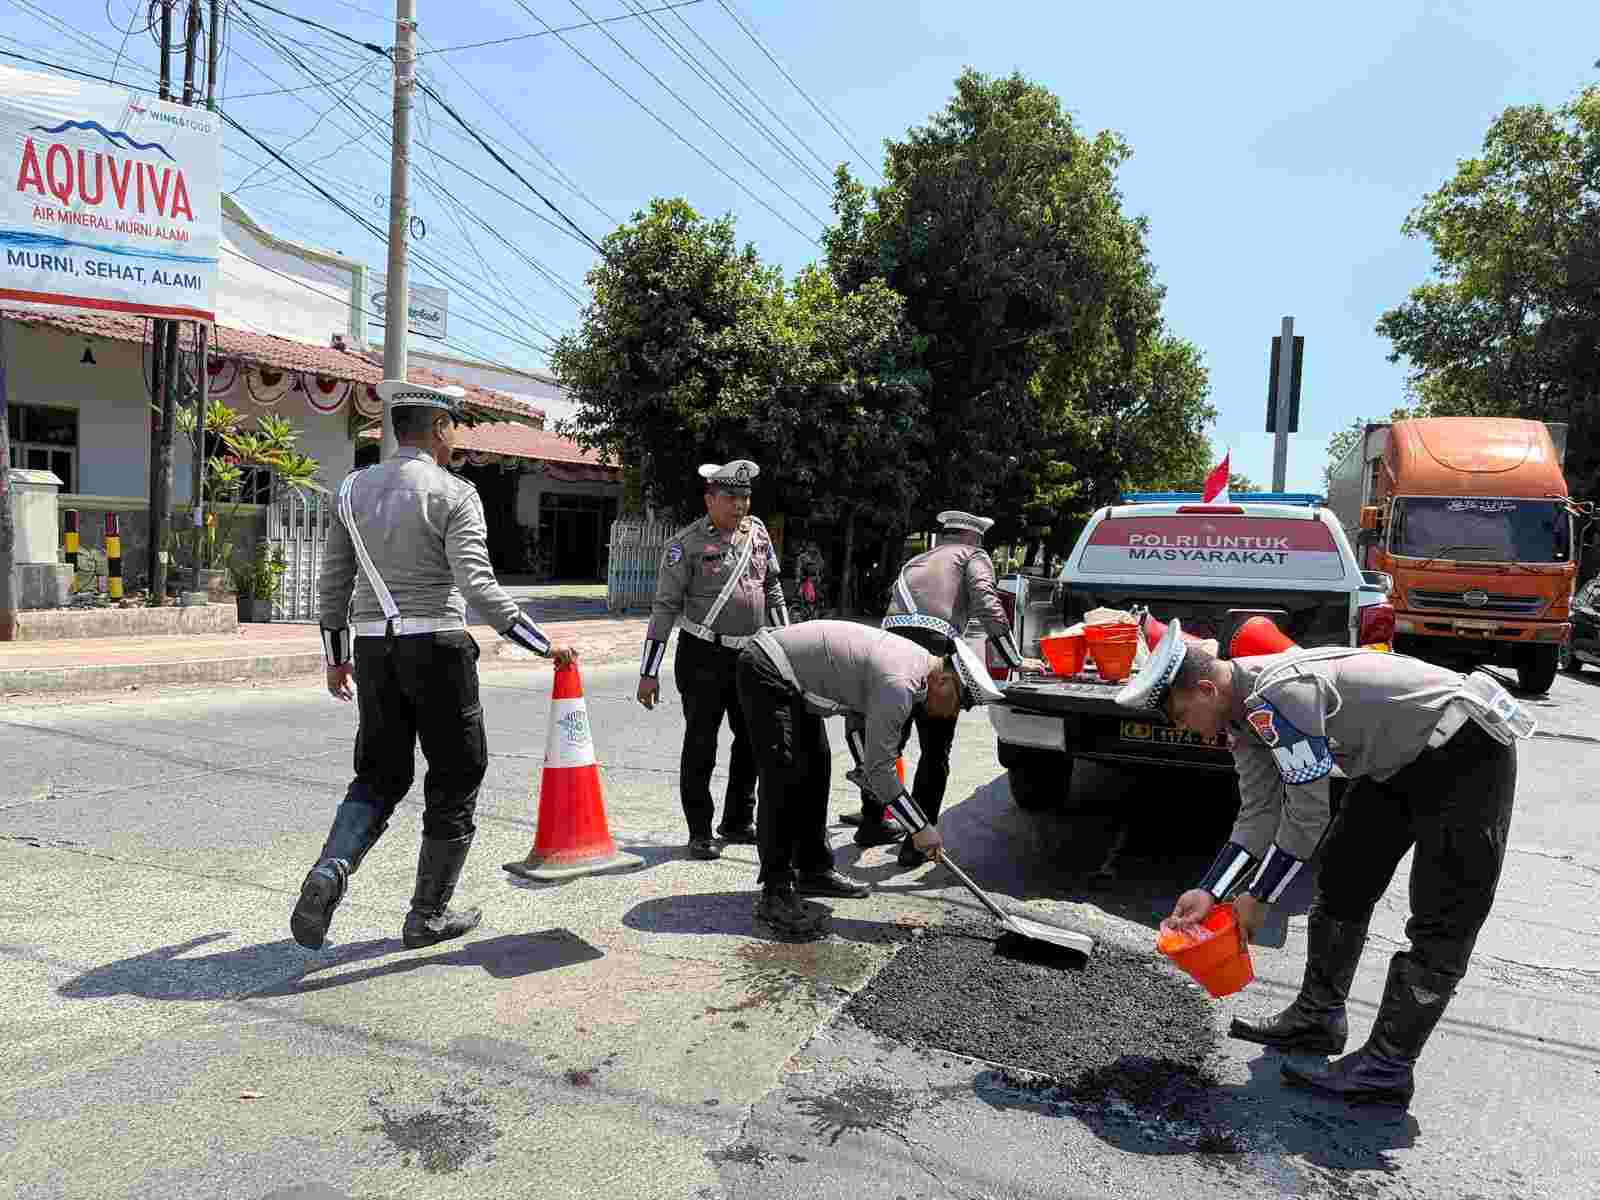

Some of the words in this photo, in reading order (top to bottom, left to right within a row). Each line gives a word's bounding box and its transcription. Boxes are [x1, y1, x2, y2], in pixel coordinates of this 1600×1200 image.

[16, 136, 193, 222] AQUVIVA
[33, 207, 55, 222] AIR
[57, 209, 112, 231] MINERAL
[115, 220, 154, 236] MURNI
[155, 226, 190, 242] ALAMI
[7, 249, 79, 276] MURNI,
[85, 260, 146, 285] SEHAT,
[151, 269, 201, 290] ALAMI
[1128, 534, 1198, 547] POLRI
[1206, 535, 1288, 549] UNTUK
[1128, 548, 1288, 565] MASYARAKAT
